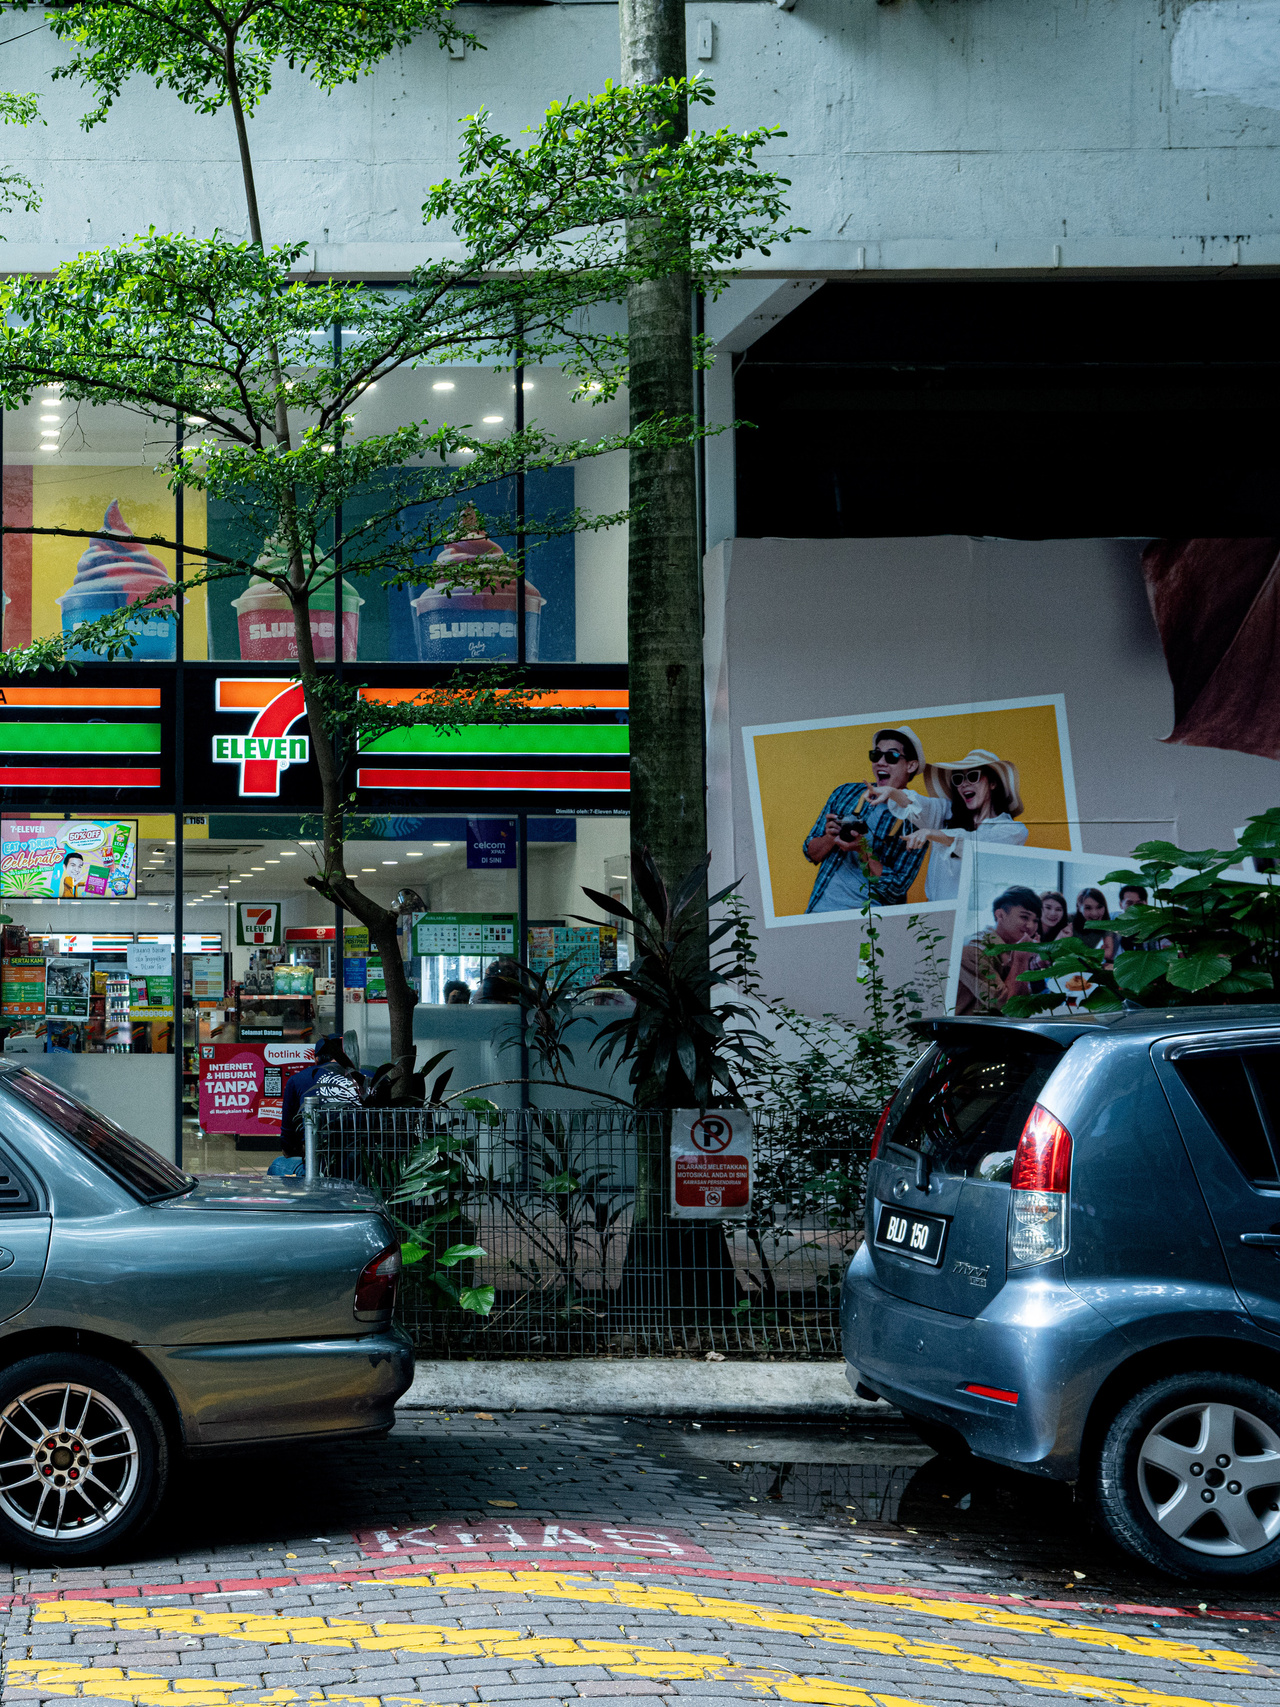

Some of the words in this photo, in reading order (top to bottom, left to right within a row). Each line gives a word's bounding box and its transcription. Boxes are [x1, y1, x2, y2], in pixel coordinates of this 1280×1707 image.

[428, 621, 517, 640] SLURPe
[69, 830, 87, 841] 50%
[87, 829, 101, 839] OFF
[473, 841, 506, 849] celcom
[1, 847, 67, 872] Celebrate
[264, 1029, 282, 1037] Datang
[268, 1050, 301, 1059] hotlink
[209, 1062, 254, 1071] INTERNET
[206, 1072, 213, 1080] &
[214, 1071, 257, 1080] HIBURAN
[205, 1080, 259, 1094] TANPA
[214, 1094, 250, 1107] HAD
[215, 1108, 242, 1116] Rangkaian
[886, 1216, 908, 1243] BLD
[910, 1222, 930, 1250] 150
[372, 1522, 685, 1556] KHAS
